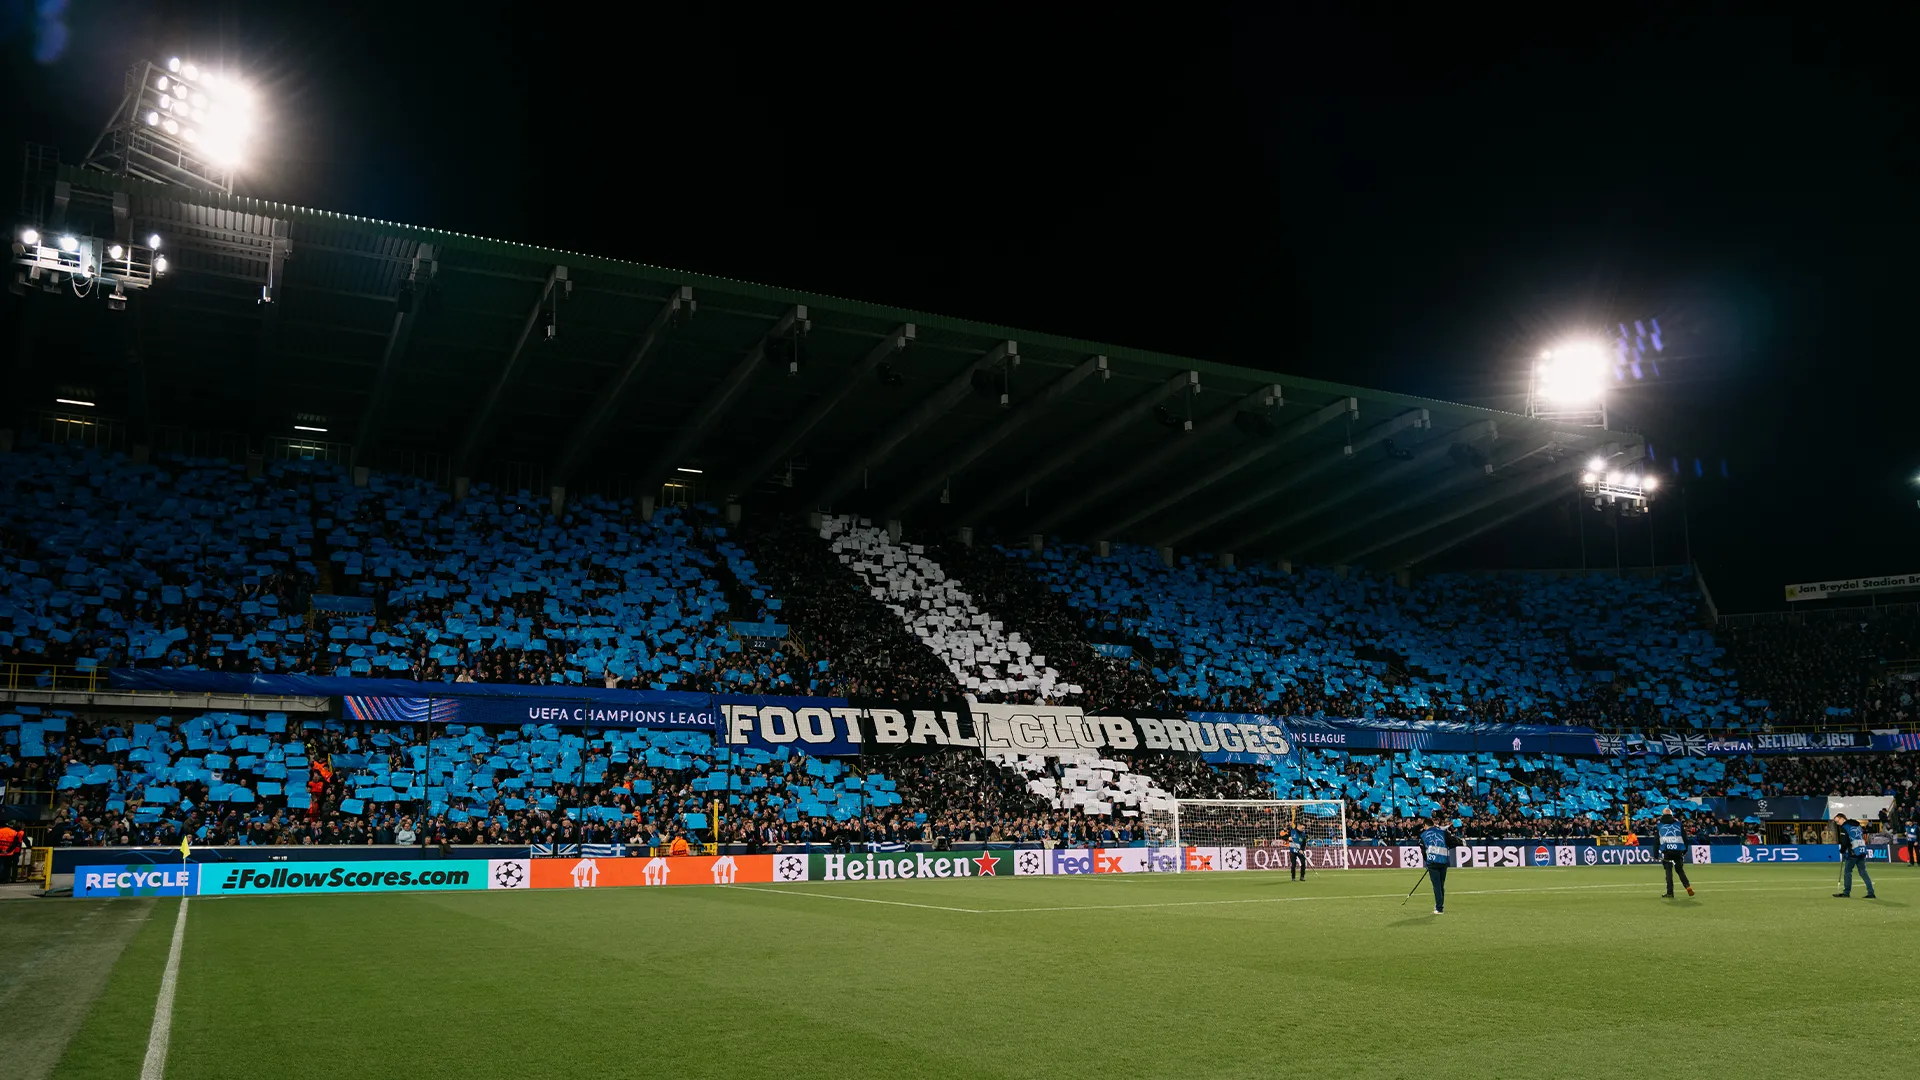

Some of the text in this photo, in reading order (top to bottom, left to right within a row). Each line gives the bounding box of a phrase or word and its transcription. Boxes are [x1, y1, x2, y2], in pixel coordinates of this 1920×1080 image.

[1798, 586, 1816, 594] Jan
[1820, 581, 1859, 593] Breydel
[1863, 577, 1905, 588] Stadion
[529, 706, 715, 725] UEFA CHAMPIONS LEAGU
[720, 704, 1289, 754] FOOTBALL CLUB BRUGES
[1309, 733, 1346, 744] LEAGUE
[1757, 732, 1855, 746] SECTION 1891
[1052, 848, 1123, 875] FedEx
[1147, 846, 1213, 872] FedEx
[1455, 845, 1526, 868] PEPSI
[1601, 846, 1659, 865] crypto.
[1756, 847, 1799, 861] PS5
[823, 853, 971, 881] Heineken
[85, 871, 190, 888] RECYCLE
[237, 867, 470, 889] FollowScores.com
